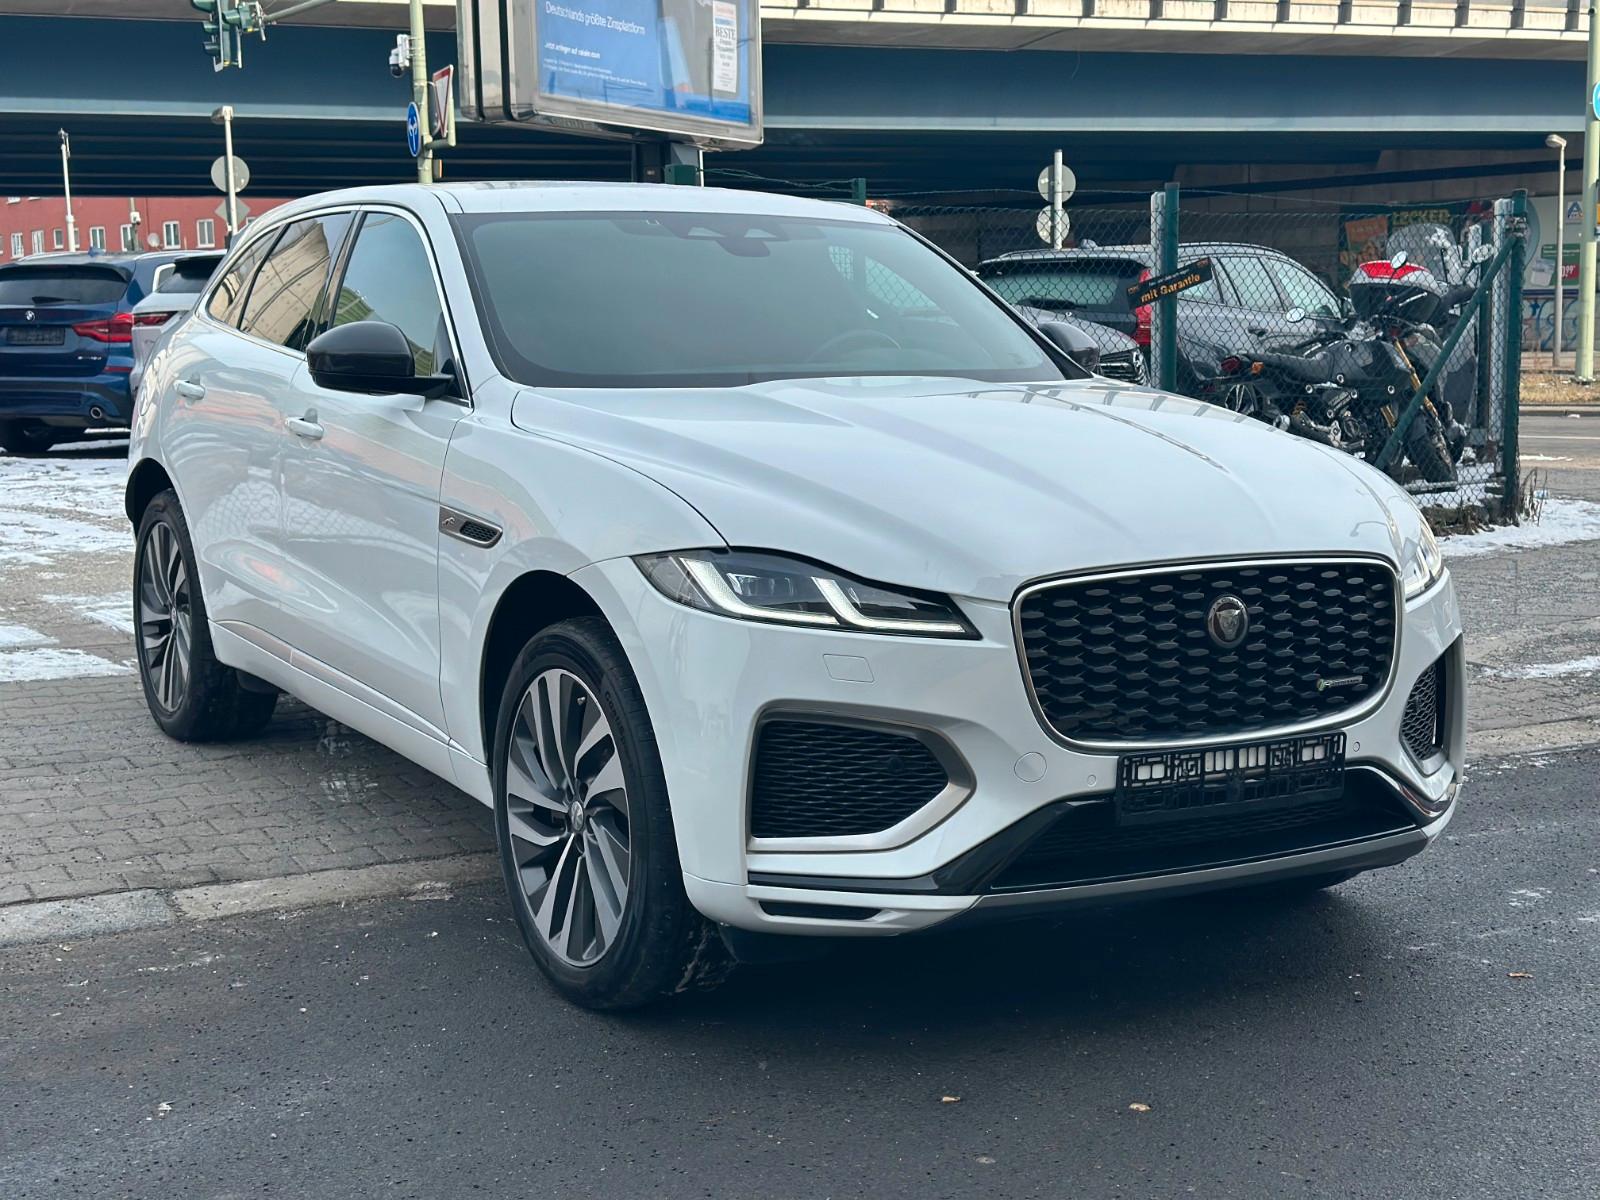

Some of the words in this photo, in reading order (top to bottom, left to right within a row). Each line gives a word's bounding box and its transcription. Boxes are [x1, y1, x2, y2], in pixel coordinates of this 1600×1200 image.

[545, 1, 585, 23] Deutschlands
[715, 26, 736, 41] BESTE
[1140, 289, 1159, 303] mit
